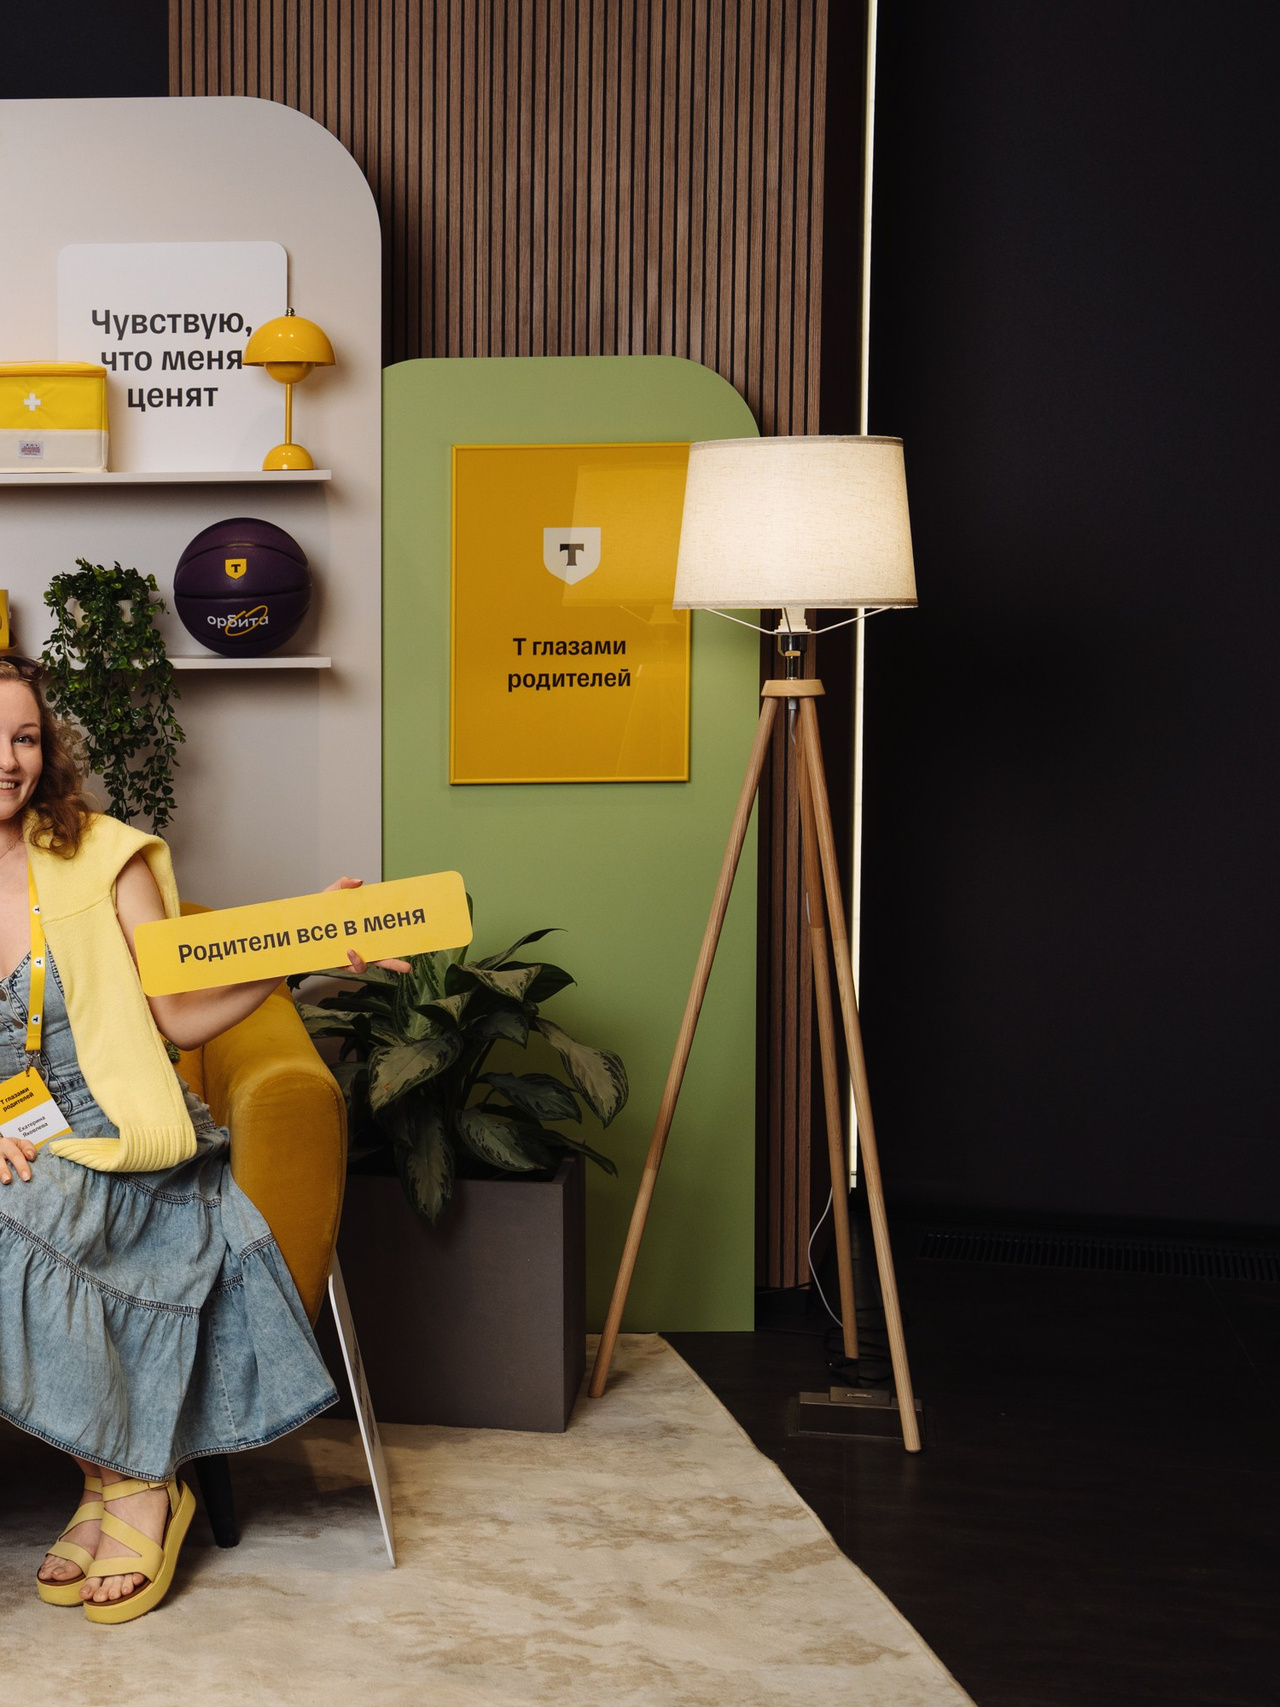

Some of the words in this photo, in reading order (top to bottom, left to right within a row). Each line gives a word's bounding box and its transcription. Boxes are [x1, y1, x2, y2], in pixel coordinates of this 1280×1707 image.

[91, 309, 253, 341] Чувствую,
[101, 351, 153, 372] что
[161, 350, 243, 371] меня
[127, 387, 219, 412] ценят
[559, 543, 585, 567] Т
[231, 564, 241, 573] Т
[512, 637, 527, 656] Т
[532, 639, 627, 656] глазами
[507, 668, 631, 693] родителей
[177, 928, 291, 964] Родители
[297, 922, 338, 945] все
[343, 919, 358, 936] в
[363, 908, 426, 934] меня
[2, 1091, 35, 1113] родителей
[5, 1087, 30, 1103] глазами
[17, 1115, 46, 1133] Екатерина
